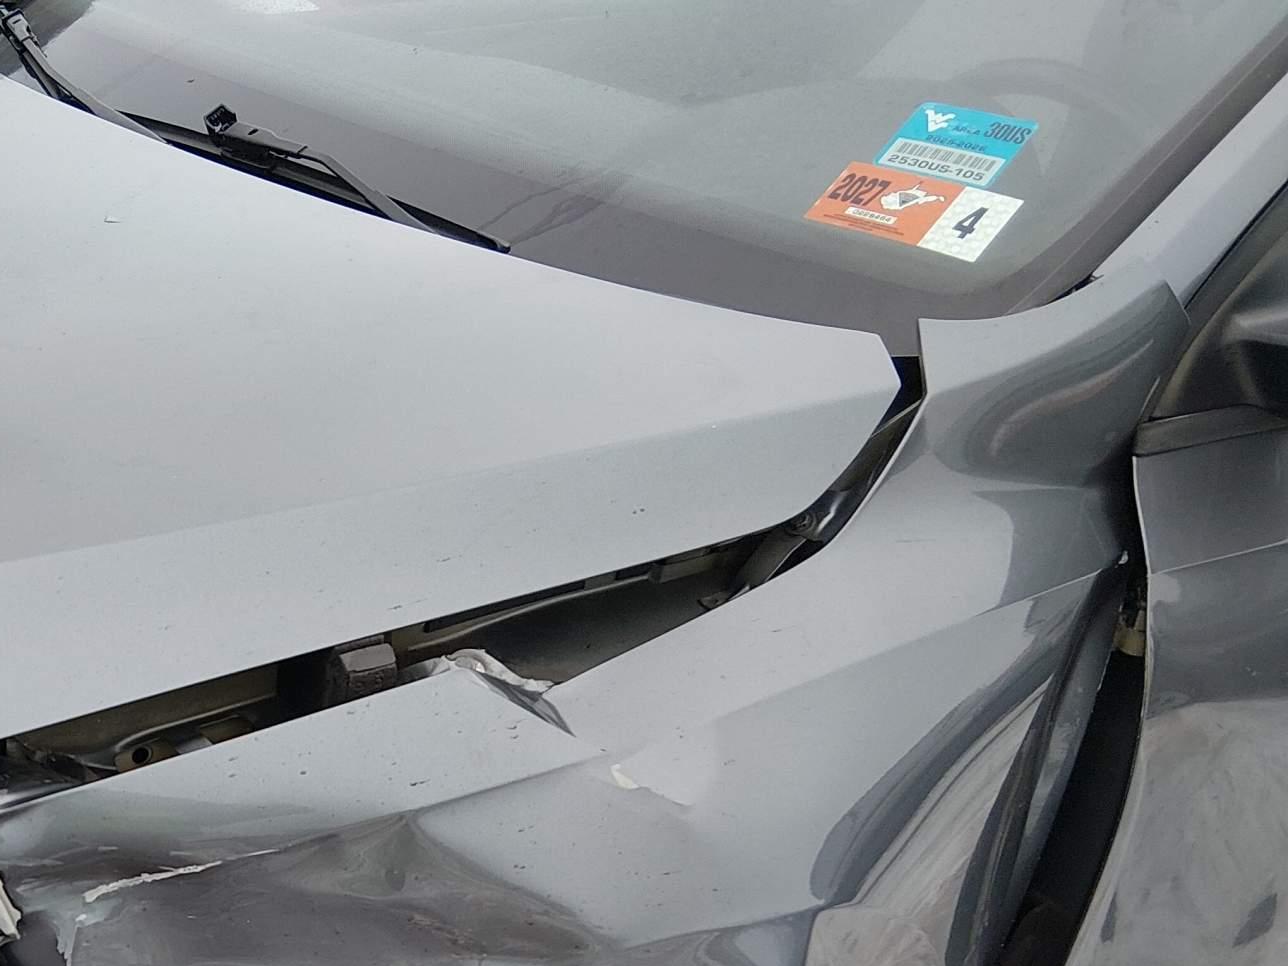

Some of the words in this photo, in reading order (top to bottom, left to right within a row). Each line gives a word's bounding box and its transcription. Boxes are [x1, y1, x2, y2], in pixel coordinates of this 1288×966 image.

[983, 121, 1032, 145] 30US
[887, 154, 985, 182] 2530US-105
[828, 173, 892, 206] 2027
[952, 207, 990, 239] 4
